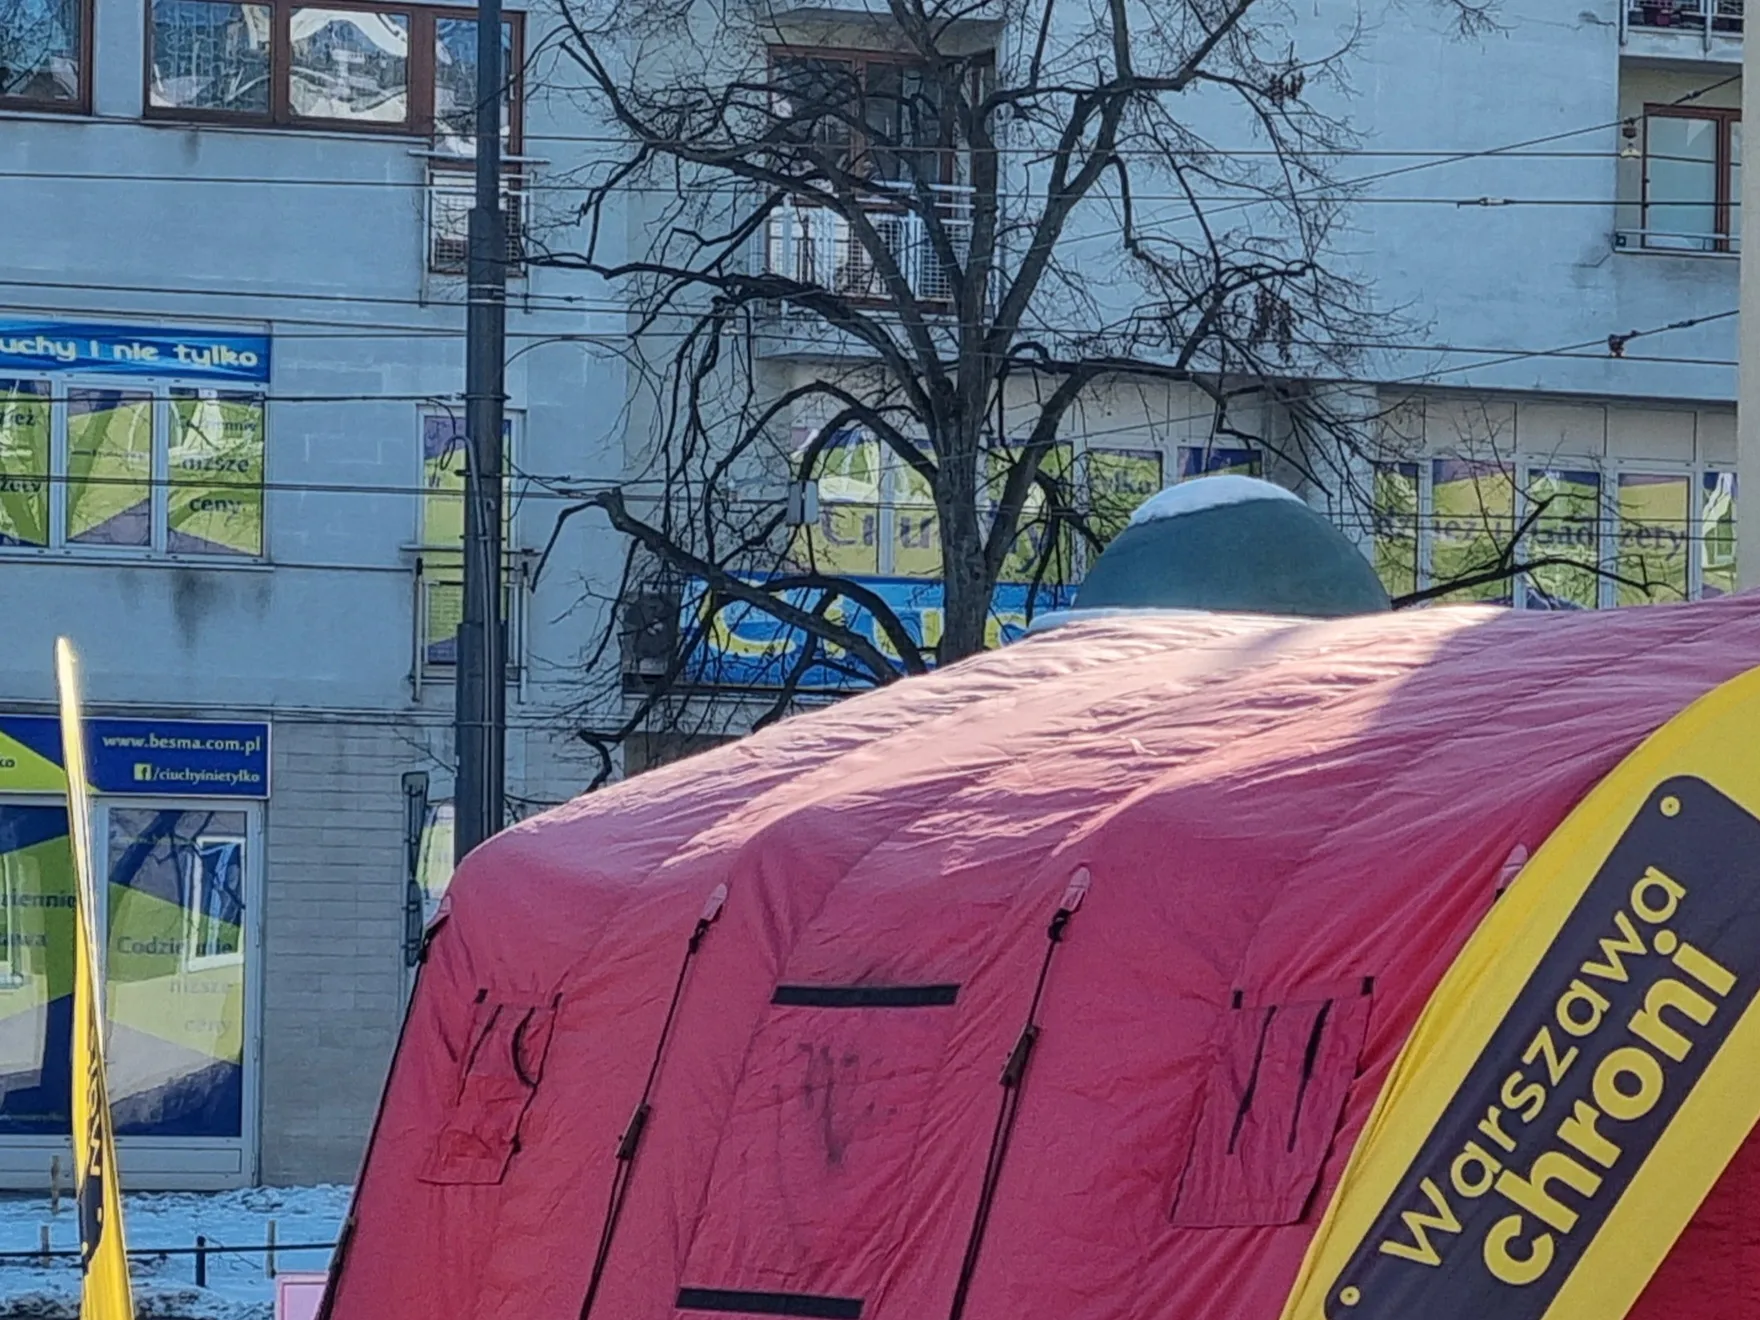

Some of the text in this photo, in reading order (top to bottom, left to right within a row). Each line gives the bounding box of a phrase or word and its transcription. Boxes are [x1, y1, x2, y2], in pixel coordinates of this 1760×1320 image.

[112, 342, 159, 362] nie
[173, 343, 258, 367] tylko
[102, 732, 261, 756] www.besma.com.pl
[1380, 866, 1687, 1267] Warszawa
[1483, 929, 1738, 1287] chroni
